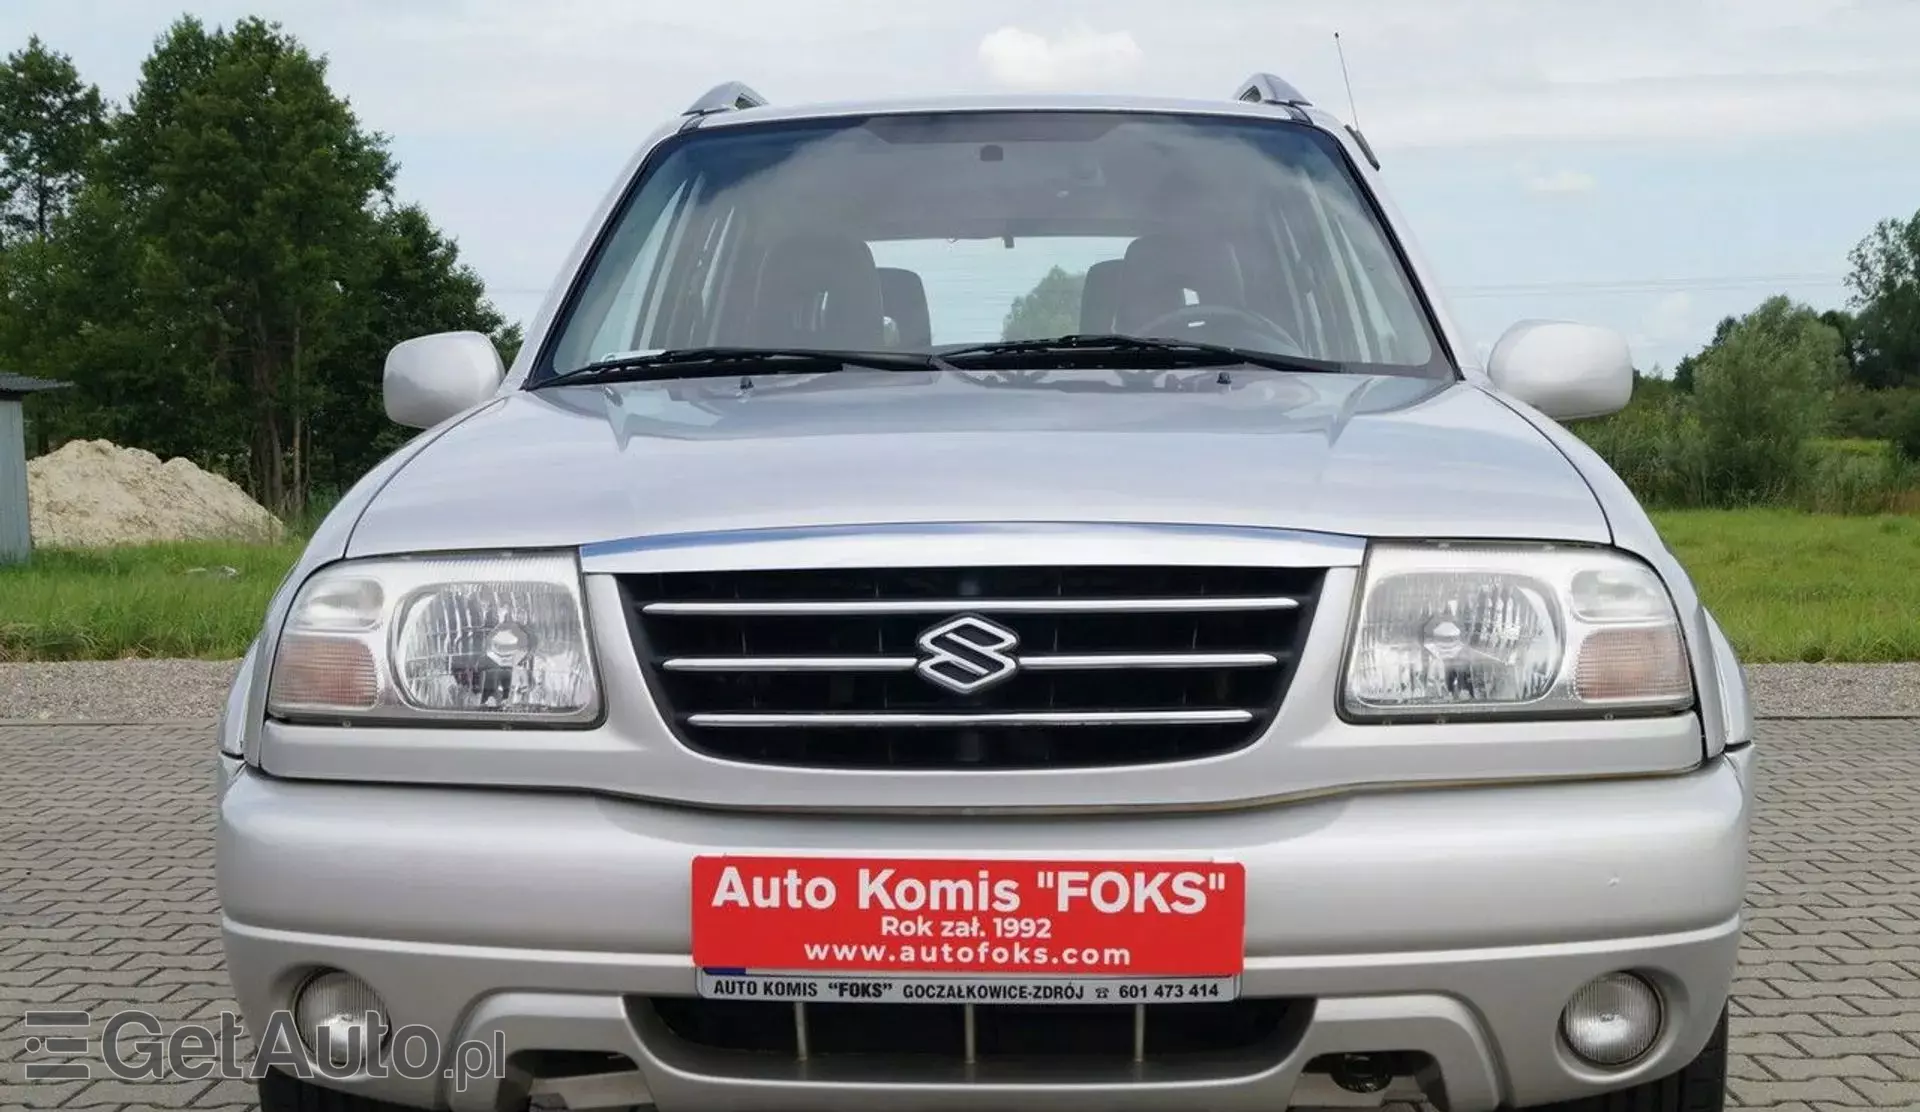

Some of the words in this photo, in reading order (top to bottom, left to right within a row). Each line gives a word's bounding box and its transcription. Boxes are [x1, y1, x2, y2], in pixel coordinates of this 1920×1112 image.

[711, 866, 837, 908] Auto
[858, 868, 1021, 911] Komis
[1036, 871, 1226, 914] "FOKS"
[881, 916, 932, 937] Rok
[940, 915, 986, 938] zał.
[993, 917, 1052, 938] 1992
[803, 941, 1131, 966] www.autofoks.com
[714, 981, 758, 998] AUTO
[763, 981, 818, 998] KOMIS
[902, 980, 1084, 1000] GOCZAŁKOWICE-ZDRÓJ
[1119, 982, 1148, 998] 601
[1154, 982, 1184, 998] 473
[1189, 982, 1219, 998] 414
